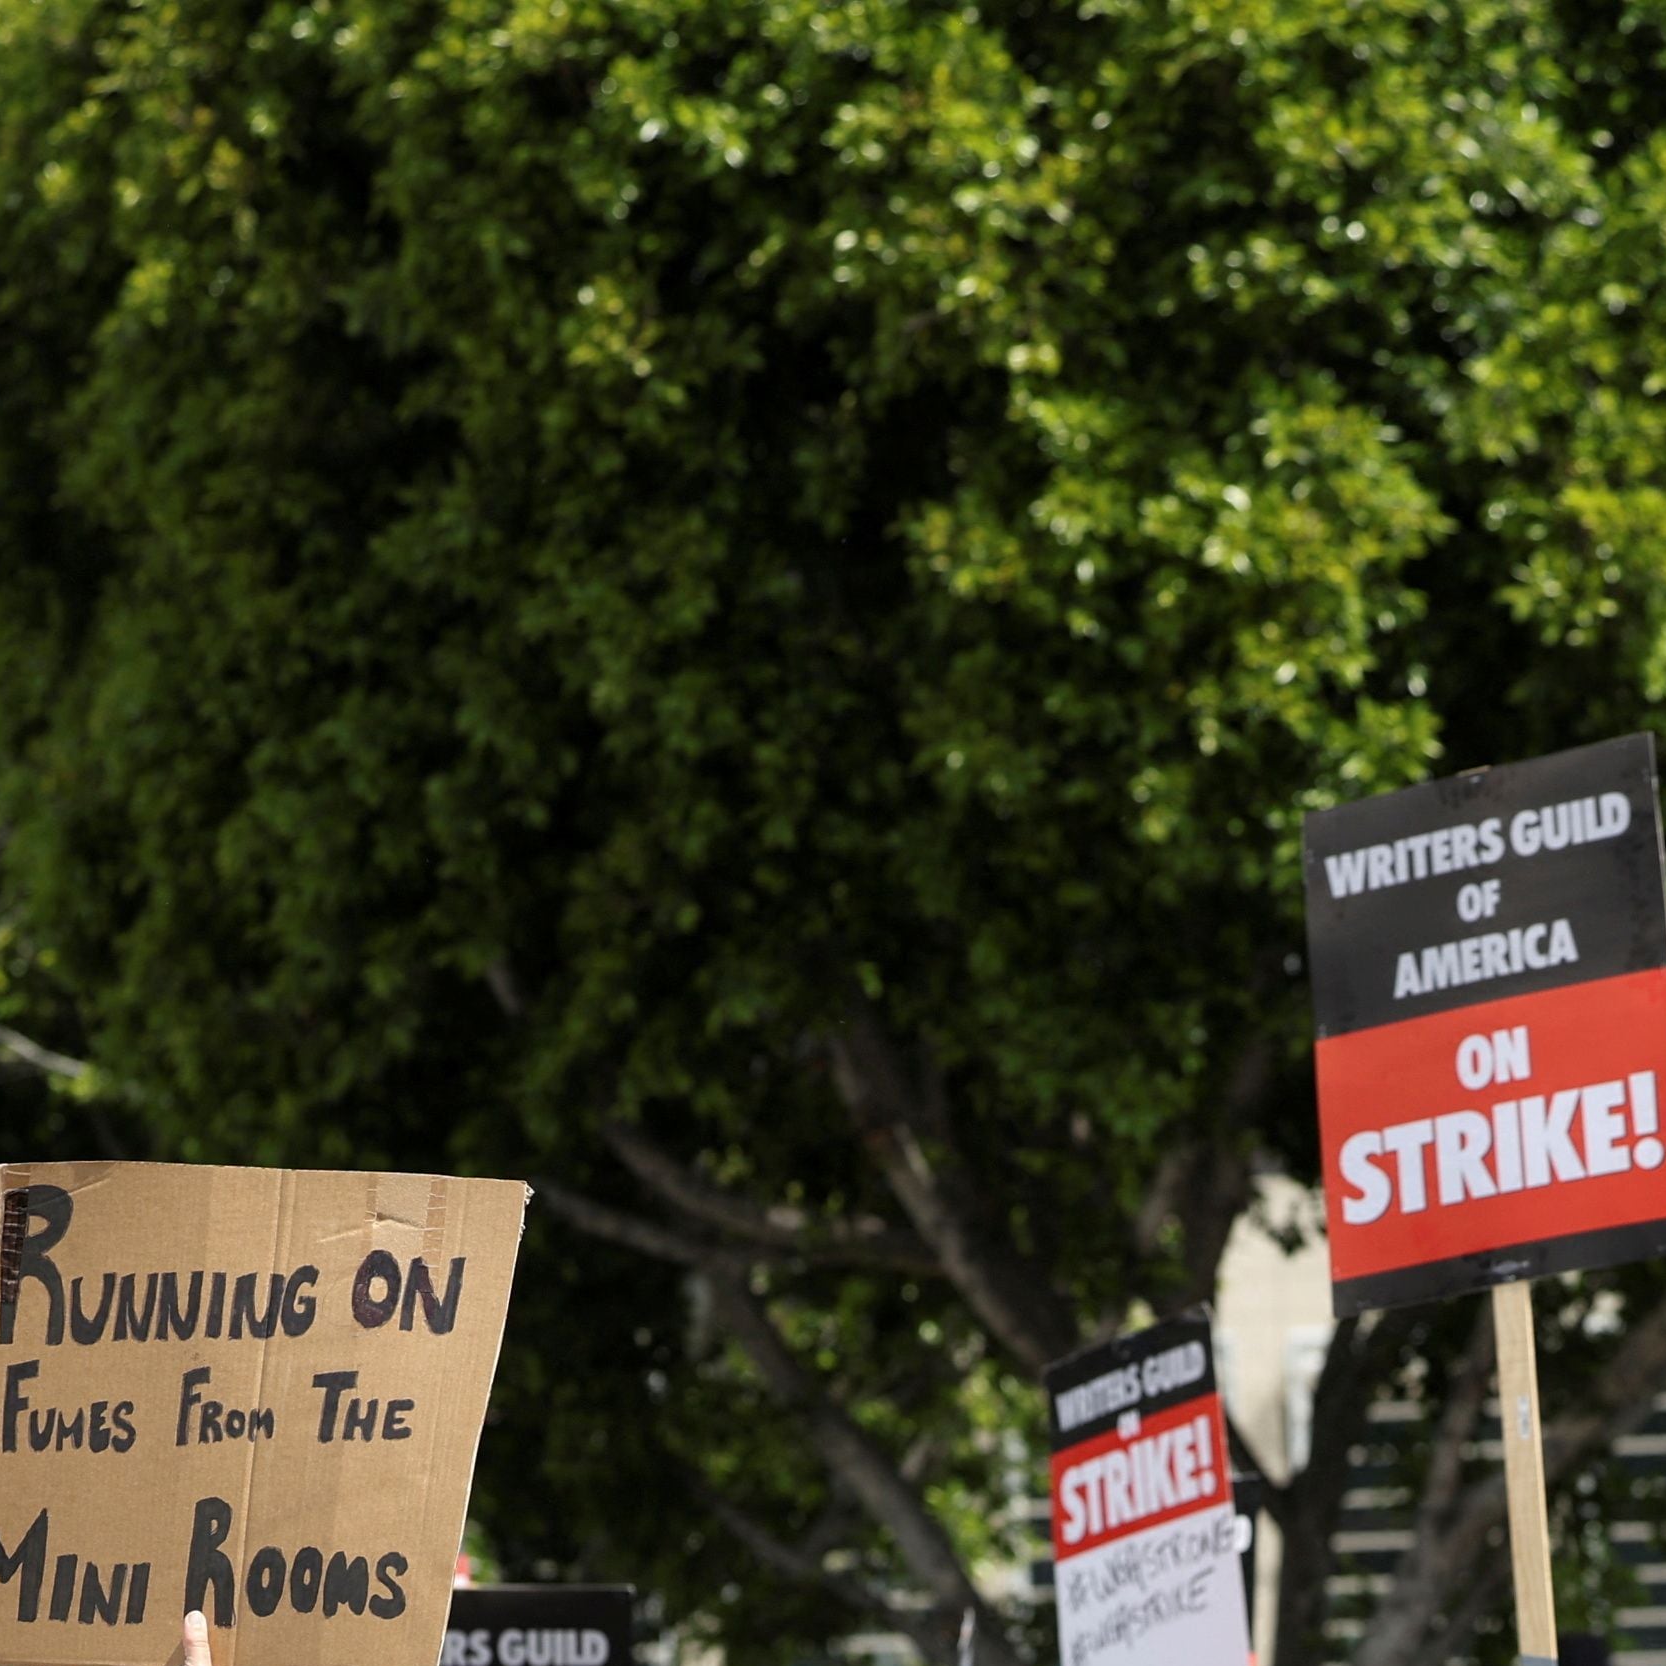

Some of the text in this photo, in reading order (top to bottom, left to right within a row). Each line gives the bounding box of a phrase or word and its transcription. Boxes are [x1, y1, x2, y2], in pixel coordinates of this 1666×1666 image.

[1324, 791, 1631, 899] WRITERS GUILD
[1456, 879, 1501, 923] OF
[1393, 919, 1579, 1000] AMERICA
[1454, 1024, 1532, 1090] ON
[1338, 1069, 1666, 1226] STRIKE!
[351, 1249, 466, 1336] ON
[1, 1359, 137, 1453] FUMES
[312, 1369, 415, 1443] THE
[1055, 1340, 1207, 1432] WRITERS GUILD
[1059, 1414, 1217, 1546] STRIKE!
[185, 1495, 409, 1629] ROOMS
